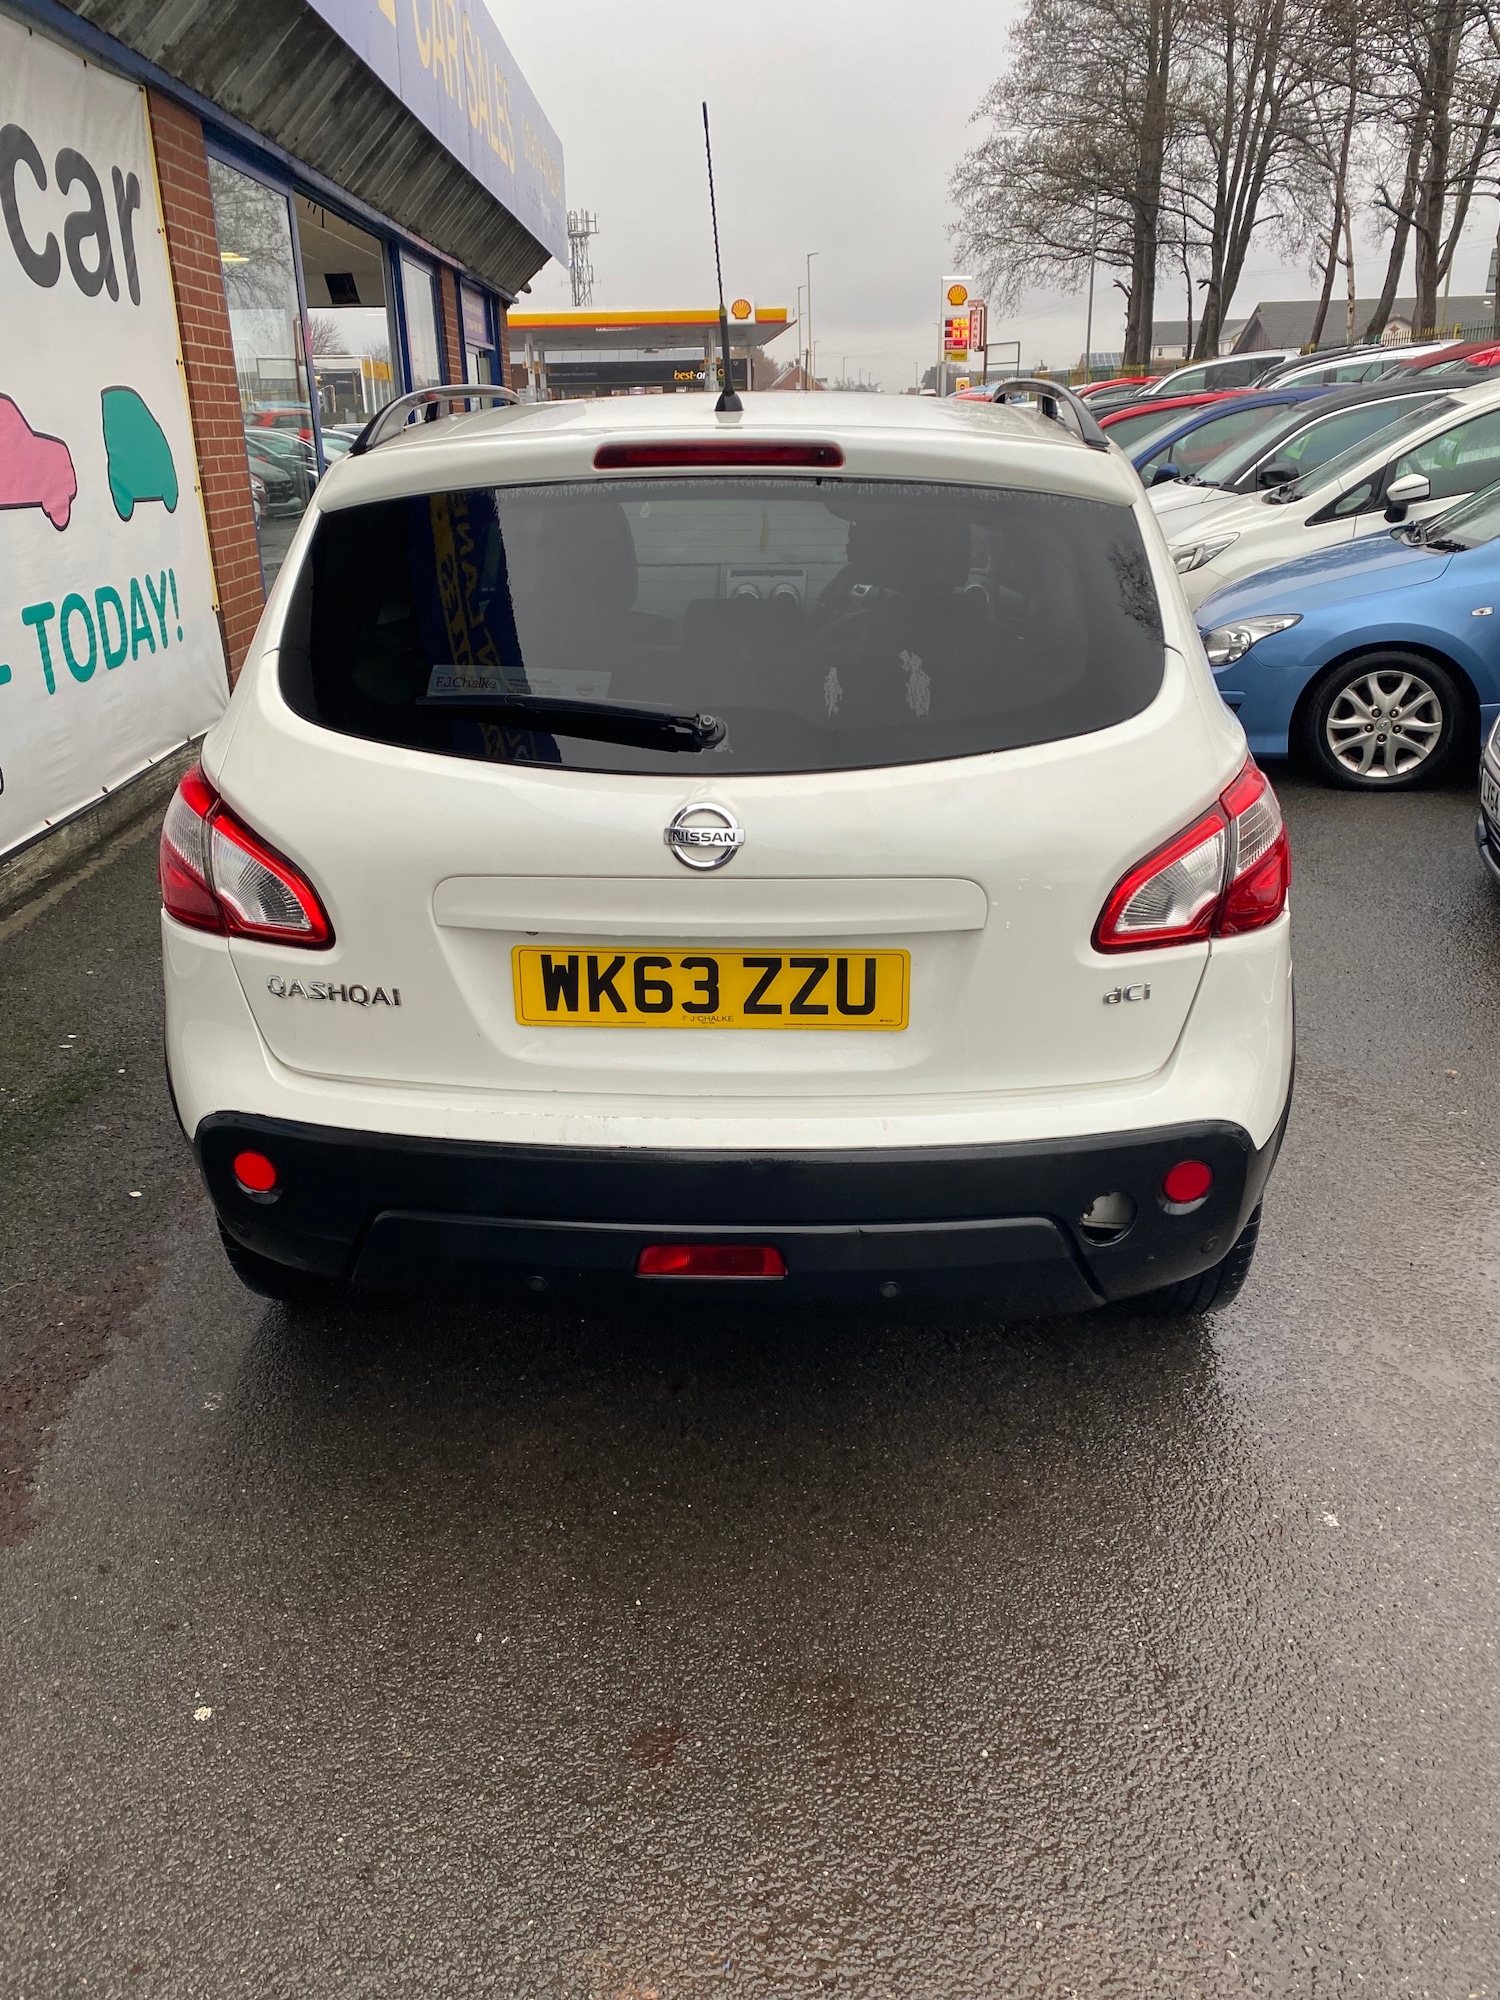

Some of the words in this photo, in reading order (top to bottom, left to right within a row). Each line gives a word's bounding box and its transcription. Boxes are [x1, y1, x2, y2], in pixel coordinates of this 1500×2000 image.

[463, 10, 515, 175] SALES
[0, 123, 141, 306] car
[674, 370, 706, 380] best-o
[21, 567, 184, 695] TODAY!
[672, 831, 736, 842] NISSAN
[267, 975, 402, 1007] QASHQAI
[540, 954, 719, 1014] WK63
[742, 957, 877, 1015] ZZU
